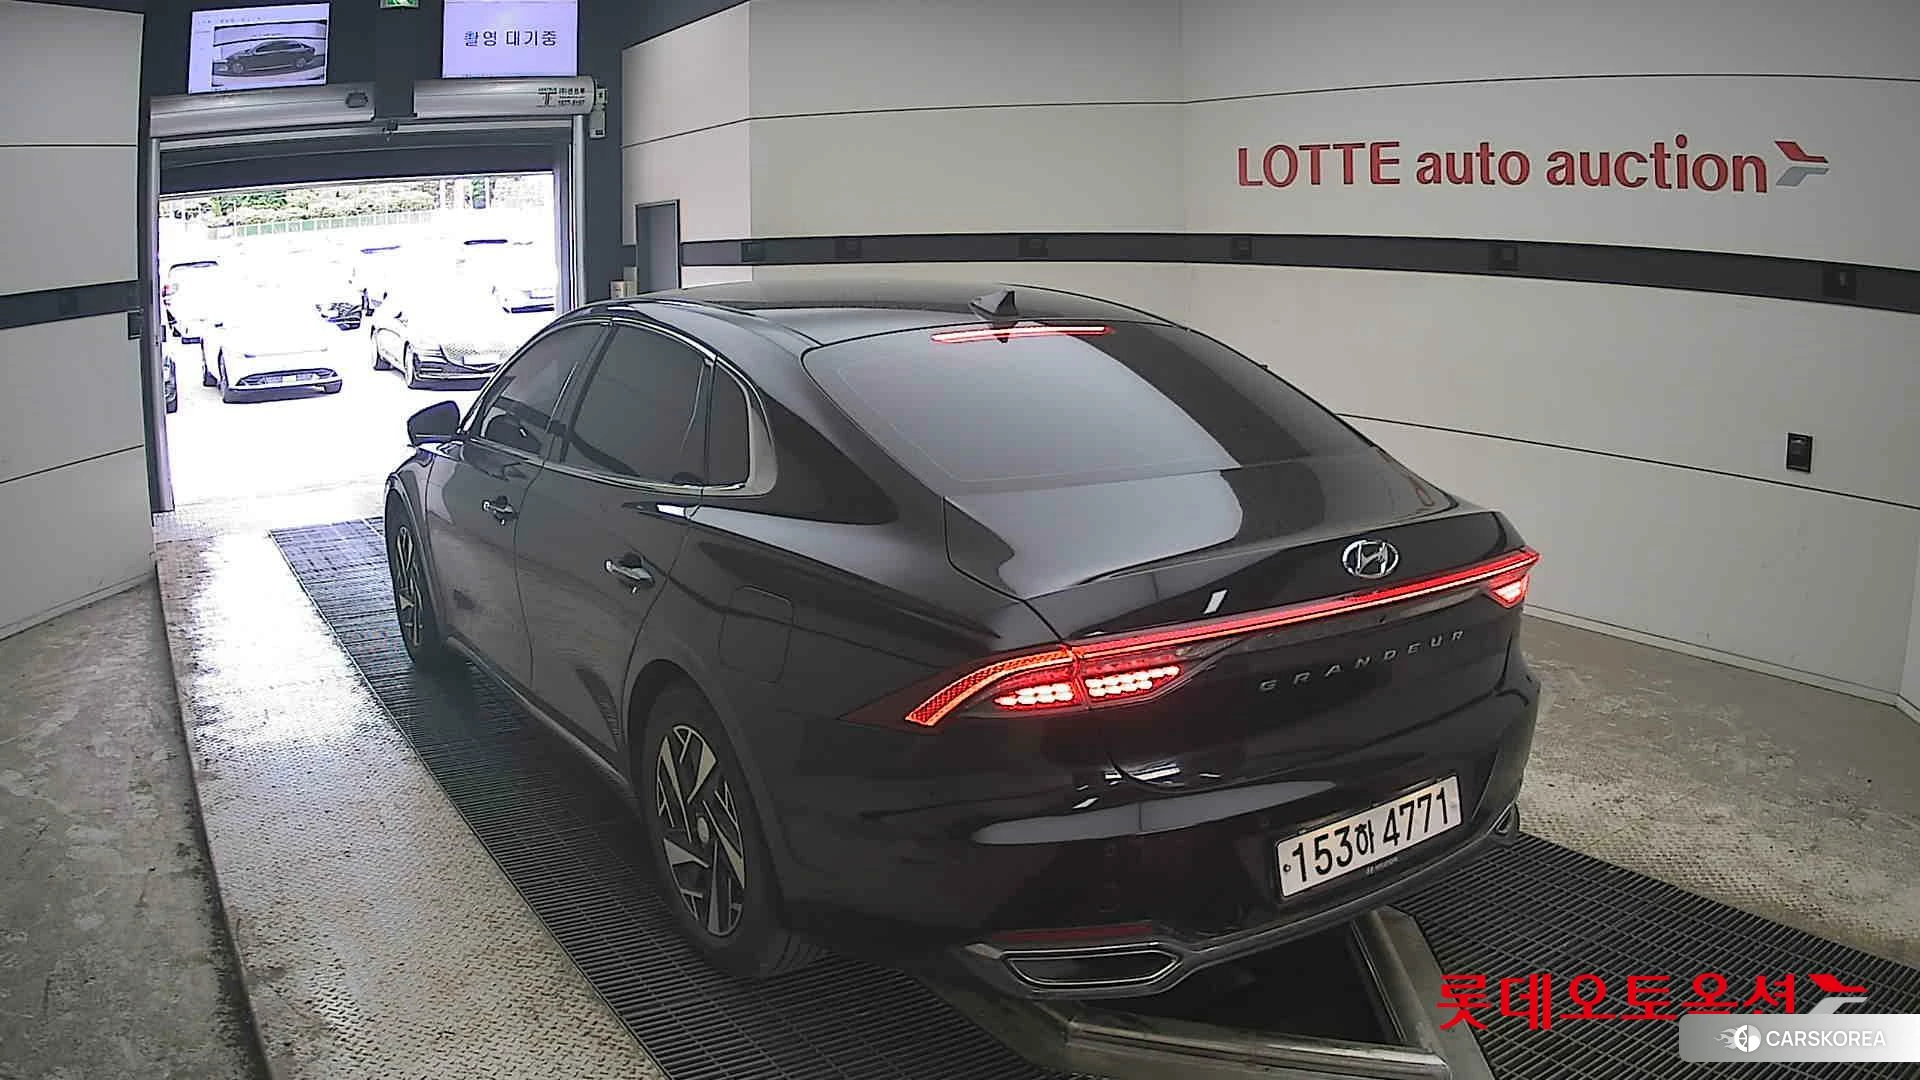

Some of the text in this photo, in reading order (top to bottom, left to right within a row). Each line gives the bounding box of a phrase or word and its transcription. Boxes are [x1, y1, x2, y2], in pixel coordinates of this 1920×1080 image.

[505, 29, 557, 47] 대기중
[1238, 134, 1768, 193] LOTTE auto auction
[1260, 630, 1464, 691] GRANDEUR
[1292, 787, 1448, 882] 153하 4771
